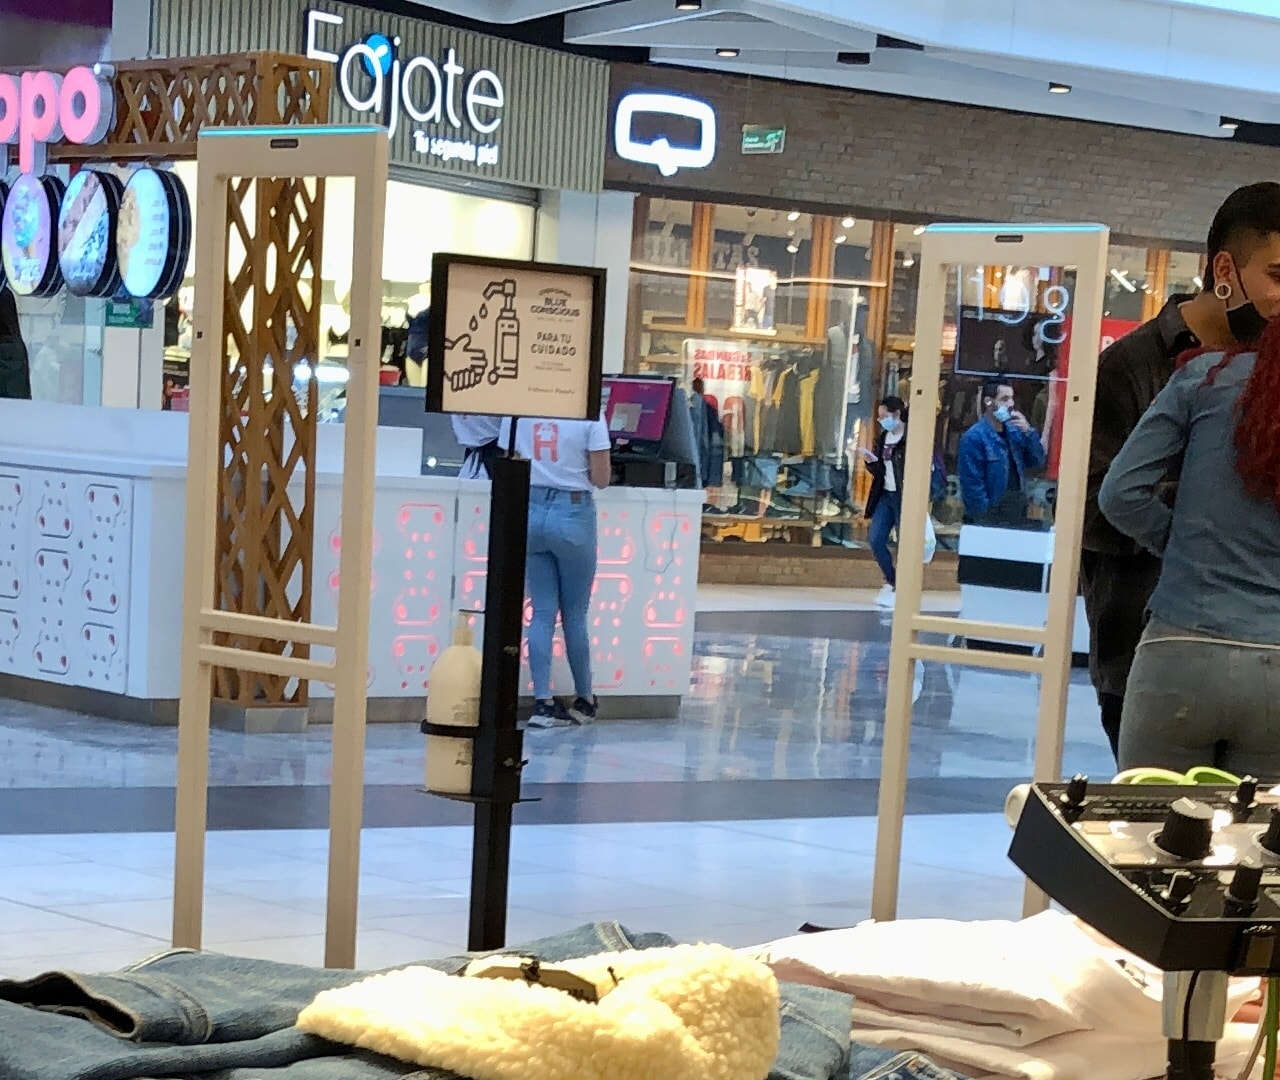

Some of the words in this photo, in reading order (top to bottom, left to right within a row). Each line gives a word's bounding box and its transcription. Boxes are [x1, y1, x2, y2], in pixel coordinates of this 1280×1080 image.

[536, 331, 558, 342] PARA
[560, 333, 572, 344] TU
[530, 343, 577, 356] CUIDADO
